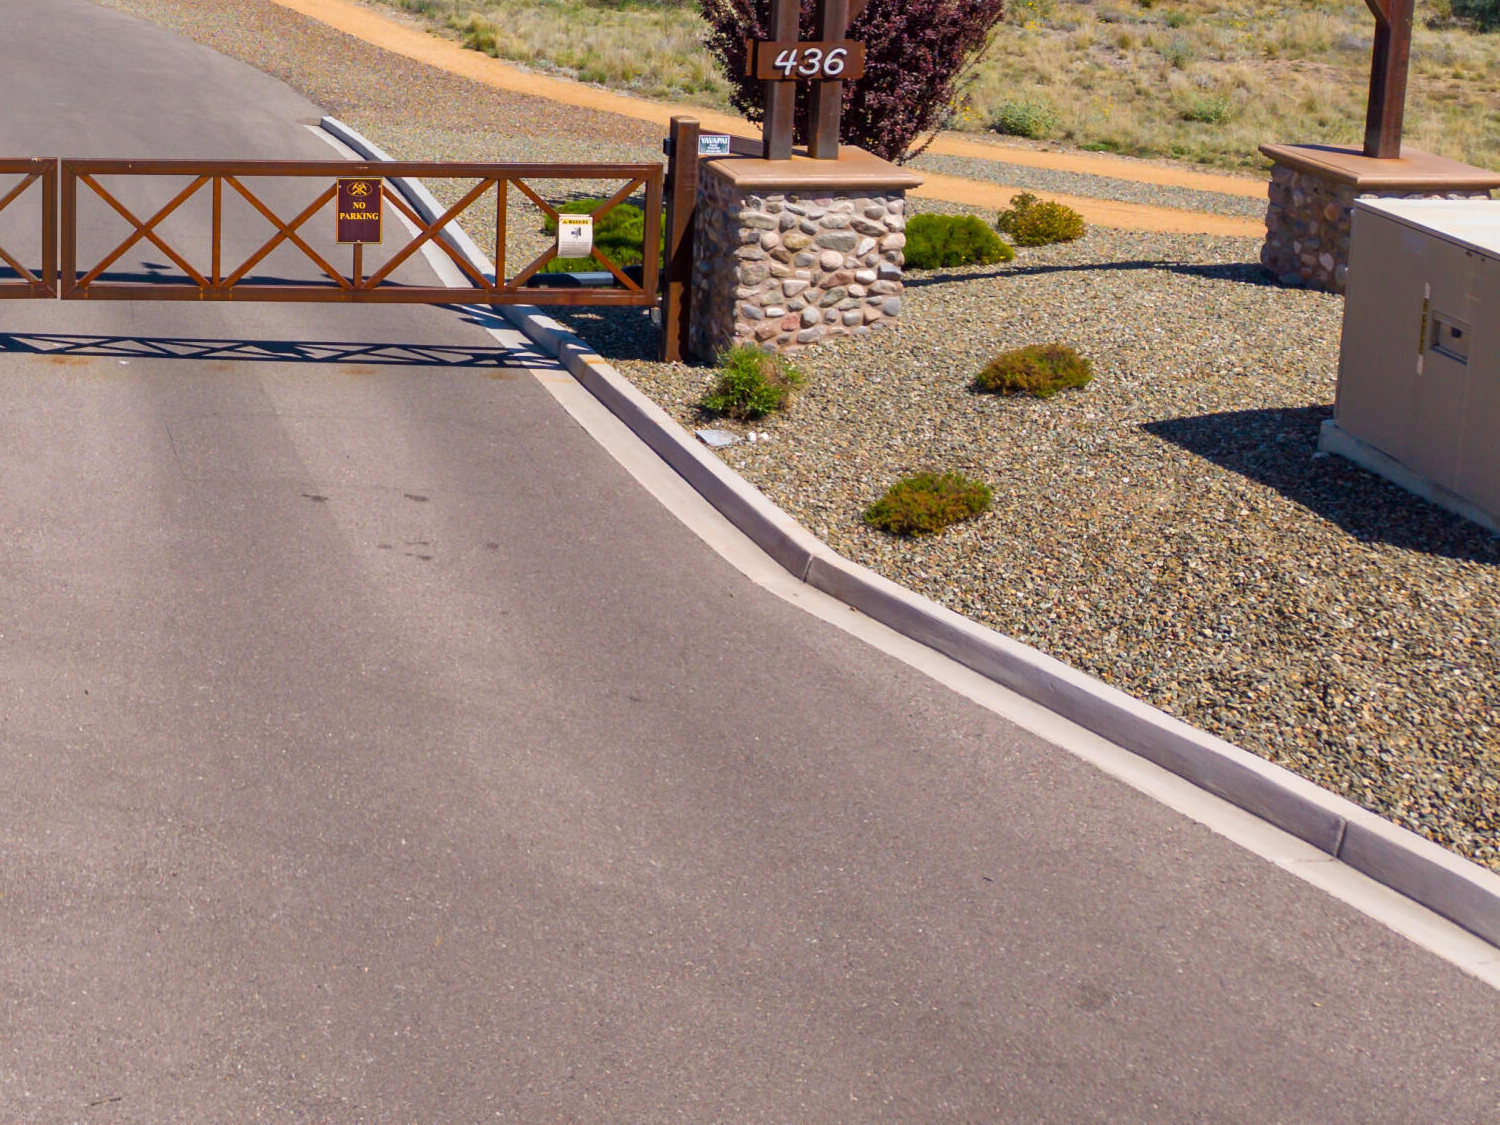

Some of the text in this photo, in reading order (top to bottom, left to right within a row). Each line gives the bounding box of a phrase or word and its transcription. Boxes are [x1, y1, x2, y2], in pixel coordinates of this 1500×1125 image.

[774, 47, 848, 76] 436
[352, 201, 366, 210] NO
[339, 212, 379, 220] PARKING
